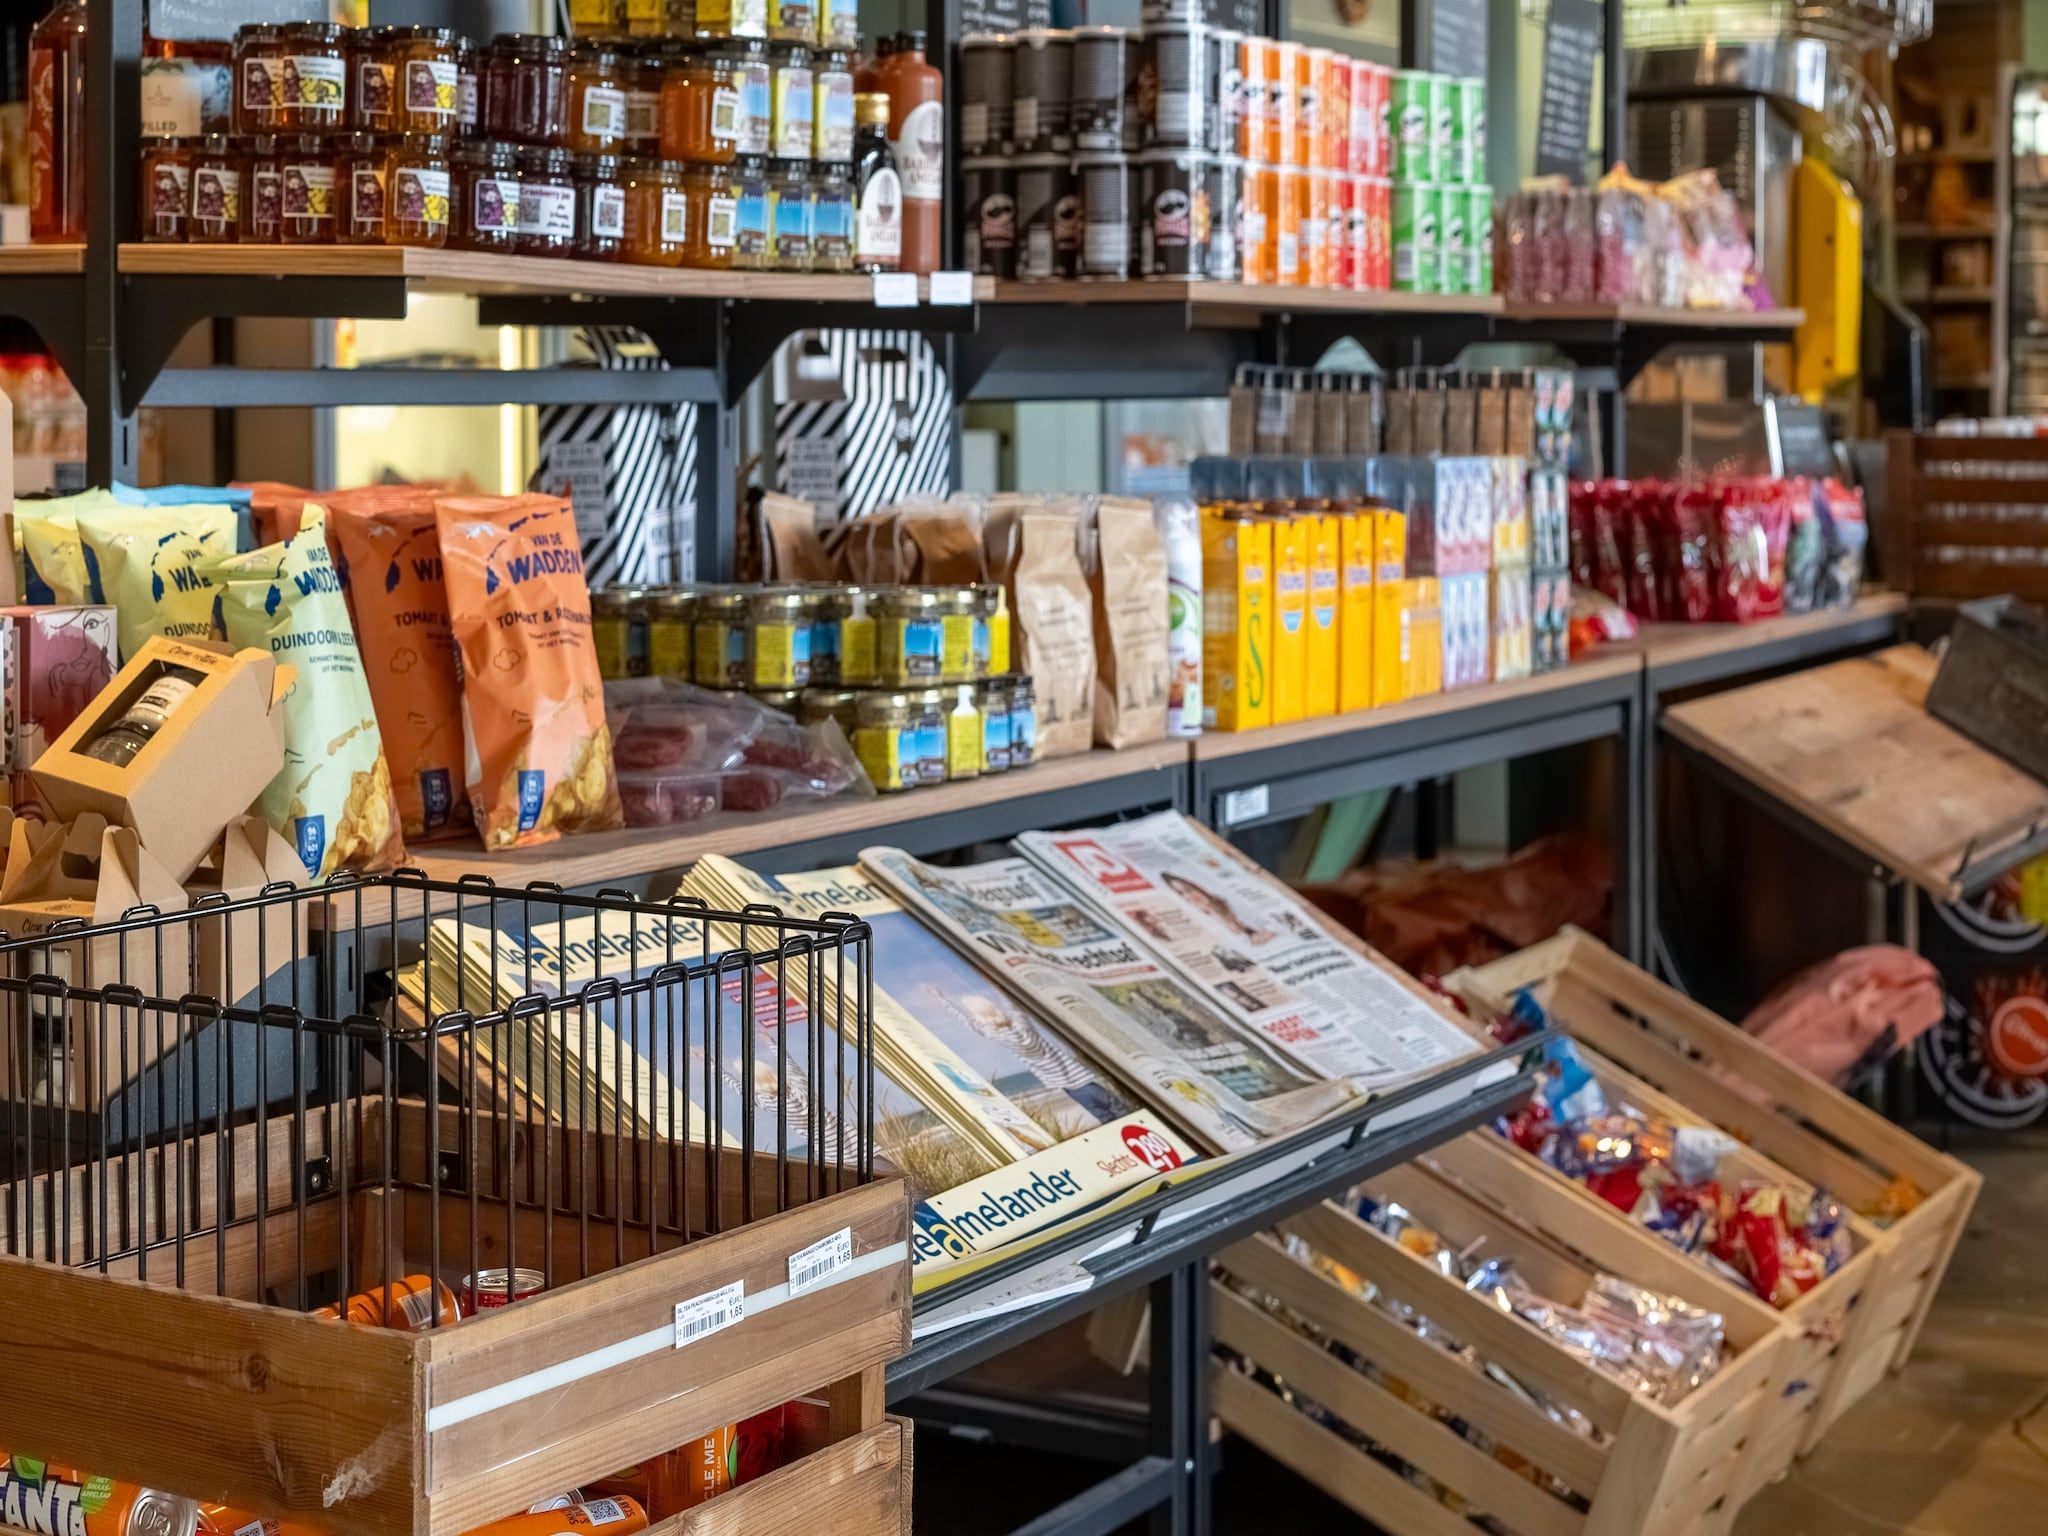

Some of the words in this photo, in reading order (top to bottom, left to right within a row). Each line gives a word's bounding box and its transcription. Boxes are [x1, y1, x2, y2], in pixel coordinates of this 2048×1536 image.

[531, 534, 548, 547] VAN
[550, 532, 562, 544] DE
[507, 549, 581, 584] WADDEN
[543, 609, 552, 622] &
[838, 1250, 851, 1264] 1,65
[729, 1304, 743, 1319] 1,65
[704, 1438, 715, 1465] ME
